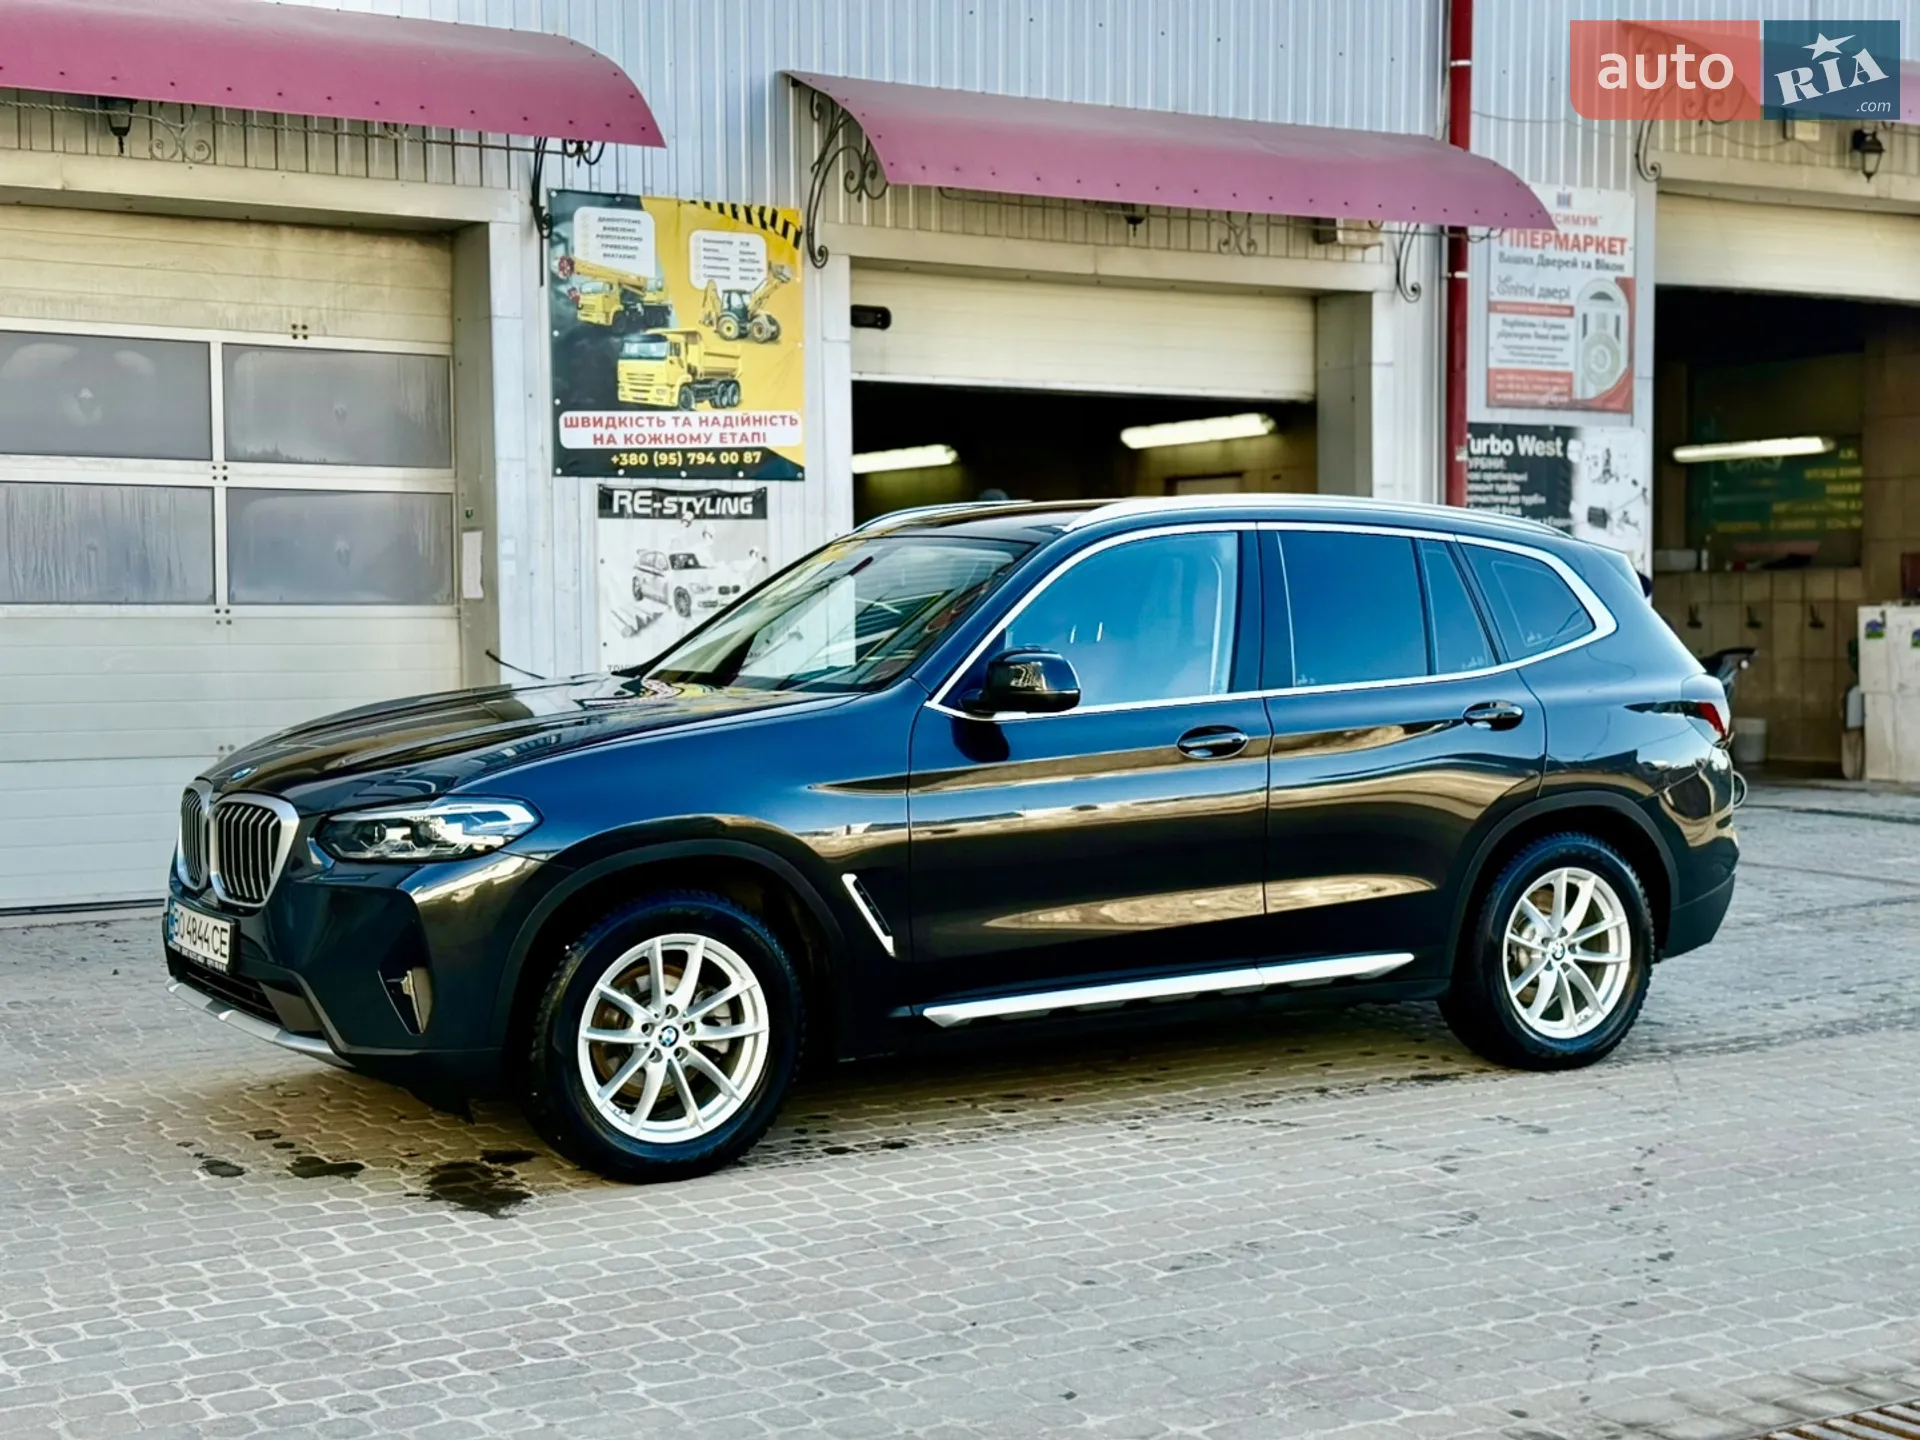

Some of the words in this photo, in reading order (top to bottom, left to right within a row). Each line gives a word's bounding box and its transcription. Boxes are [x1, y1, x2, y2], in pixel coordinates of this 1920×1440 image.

[1537, 253, 1579, 270] Дверей
[564, 415, 667, 428] ШВИДКІСТЬ
[672, 415, 691, 427] ТА
[698, 412, 798, 427] НАДІЙНІСТЬ
[593, 434, 617, 445] НА
[624, 433, 712, 445] КОЖНОМУ
[719, 432, 766, 443] ЕТАПІ
[1516, 435, 1563, 457] West
[611, 453, 648, 465] +380
[653, 453, 682, 467] (95)
[687, 452, 715, 465] 794
[720, 452, 739, 464] 00
[743, 451, 762, 464] 87
[613, 490, 754, 516] RE-STYLING
